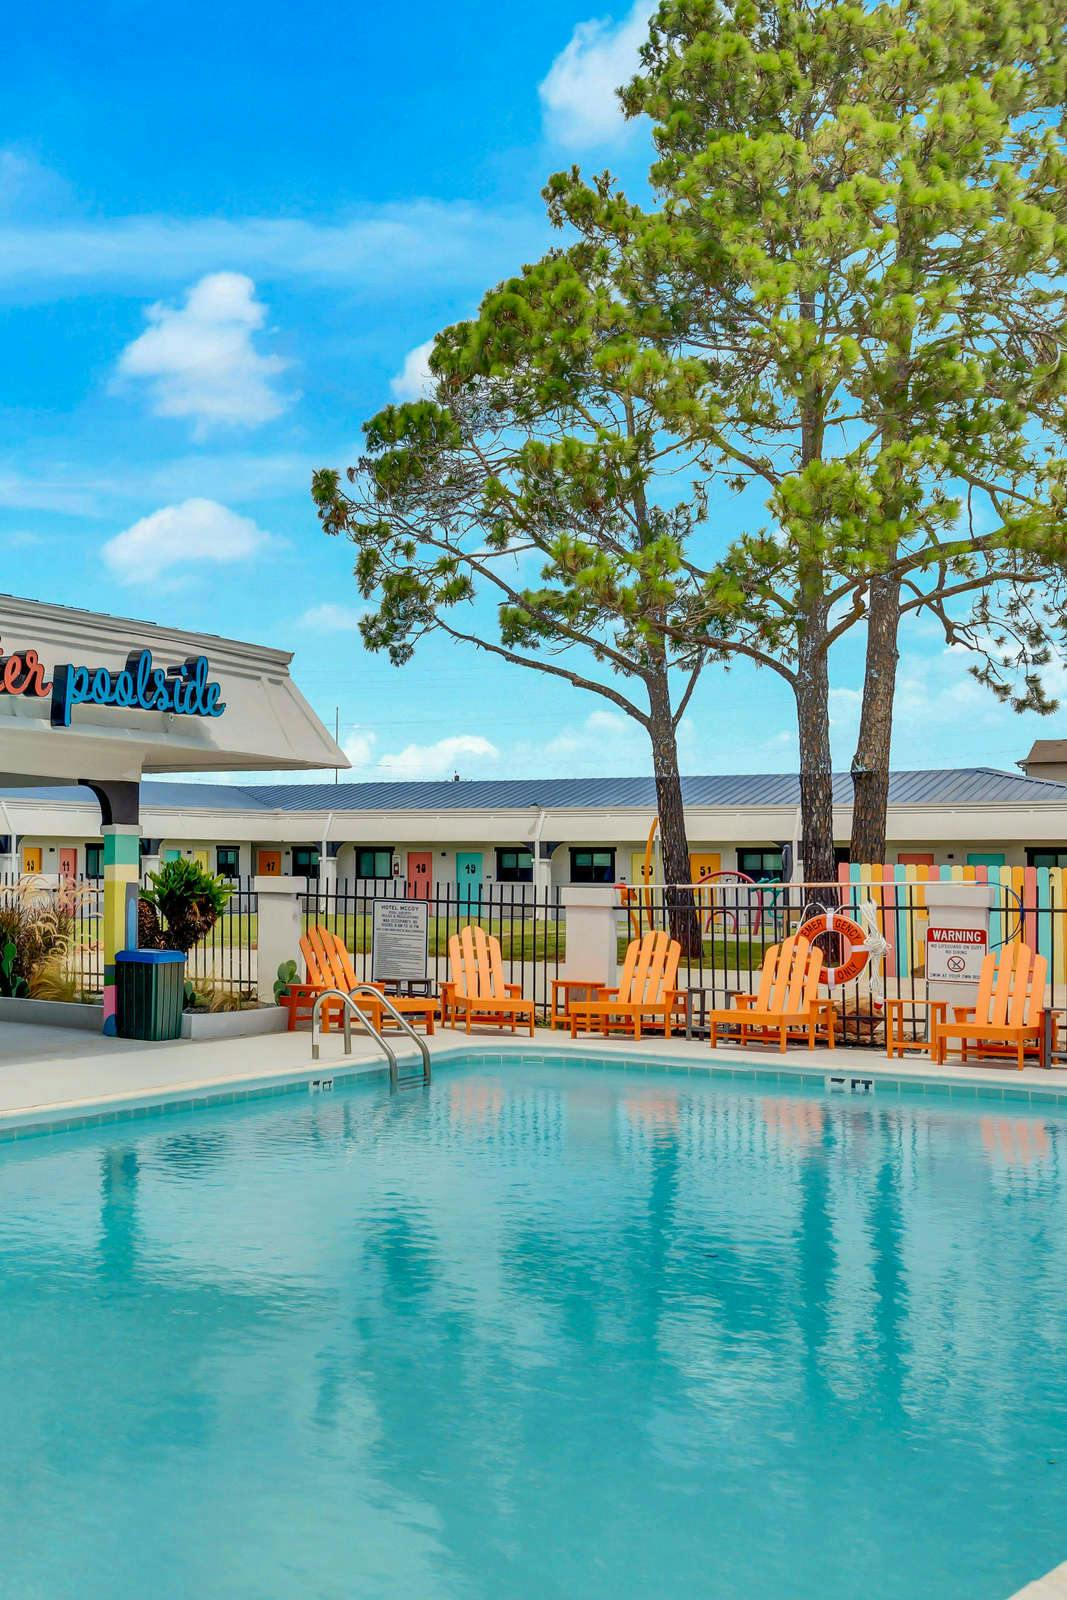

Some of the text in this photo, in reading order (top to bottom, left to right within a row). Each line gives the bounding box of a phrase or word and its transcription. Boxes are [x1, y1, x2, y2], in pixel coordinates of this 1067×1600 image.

[0, 648, 226, 728] er poolside
[465, 863, 476, 874] 49
[700, 866, 711, 877] 51
[932, 929, 982, 943] WARNING
[837, 961, 859, 980] ONLY
